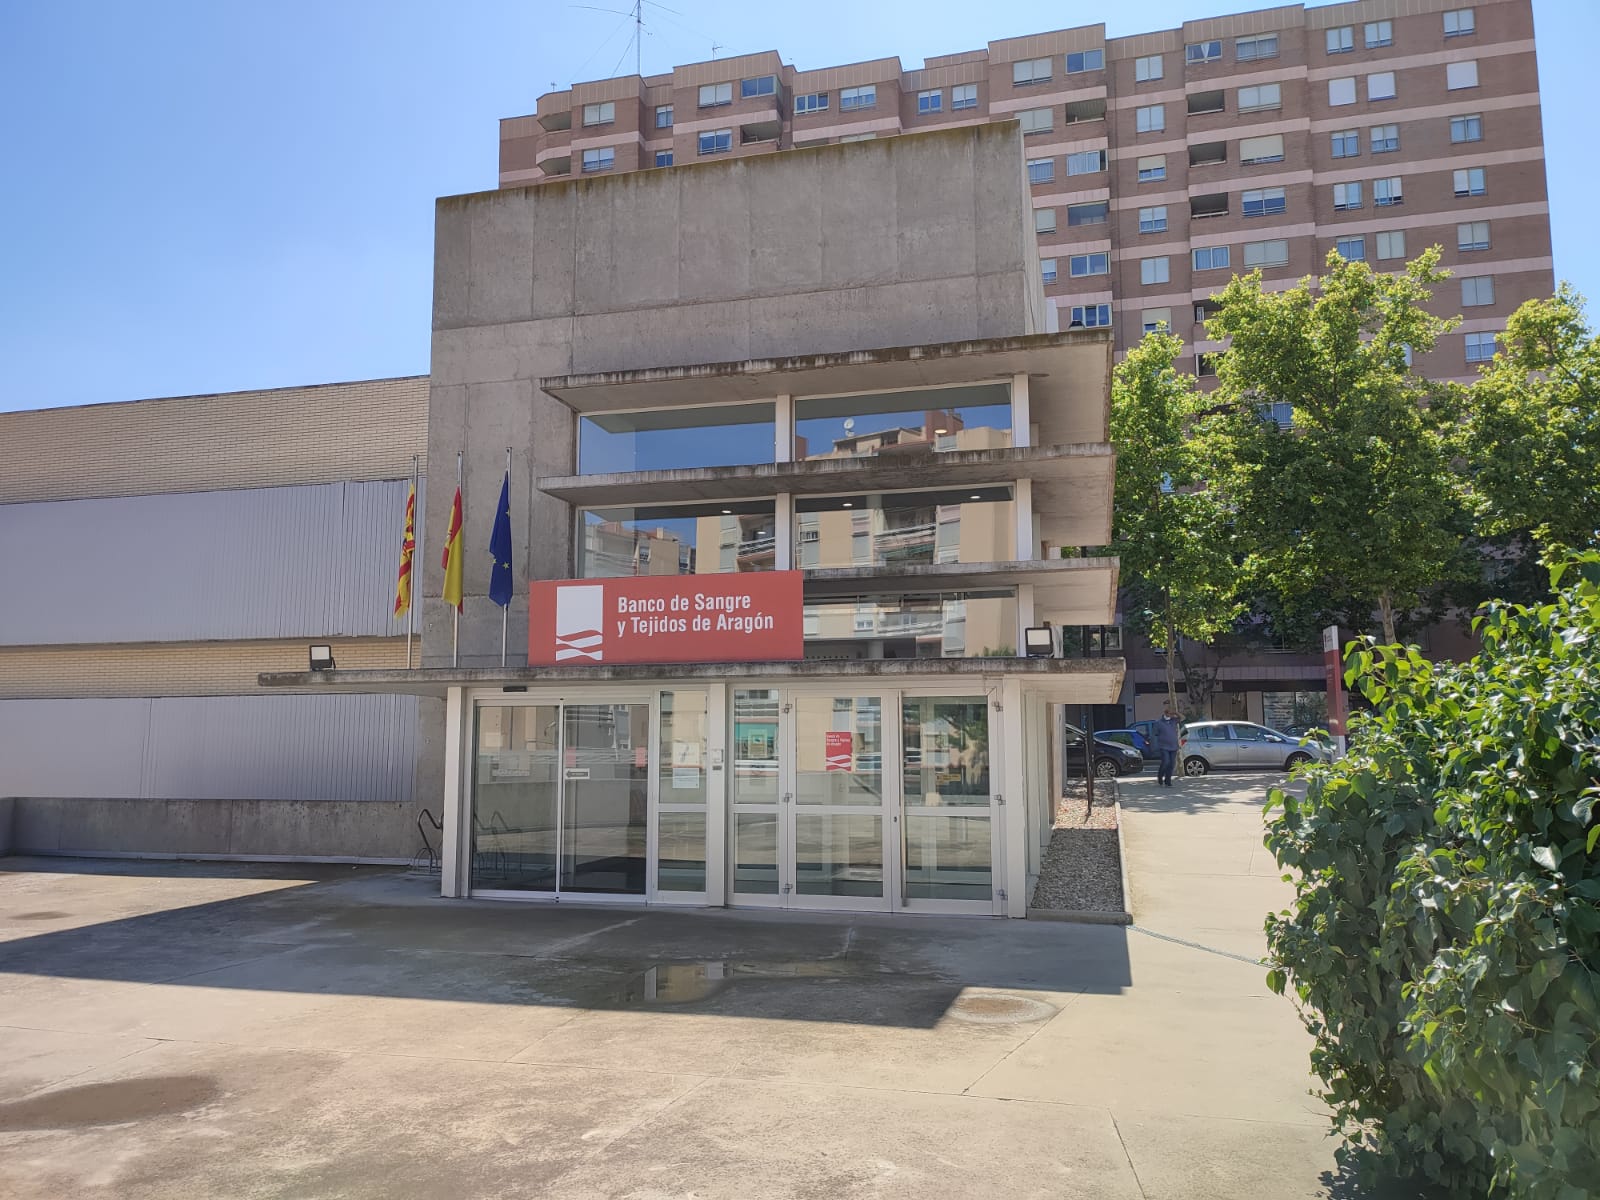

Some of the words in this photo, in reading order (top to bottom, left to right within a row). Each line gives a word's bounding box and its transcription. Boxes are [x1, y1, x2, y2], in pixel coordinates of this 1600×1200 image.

[617, 596, 665, 613] Banco
[670, 594, 690, 612] de
[694, 593, 751, 613] Sangre
[617, 620, 627, 638] y
[630, 616, 687, 637] Tejidos
[692, 614, 711, 632] de
[716, 611, 774, 634] Aragón
